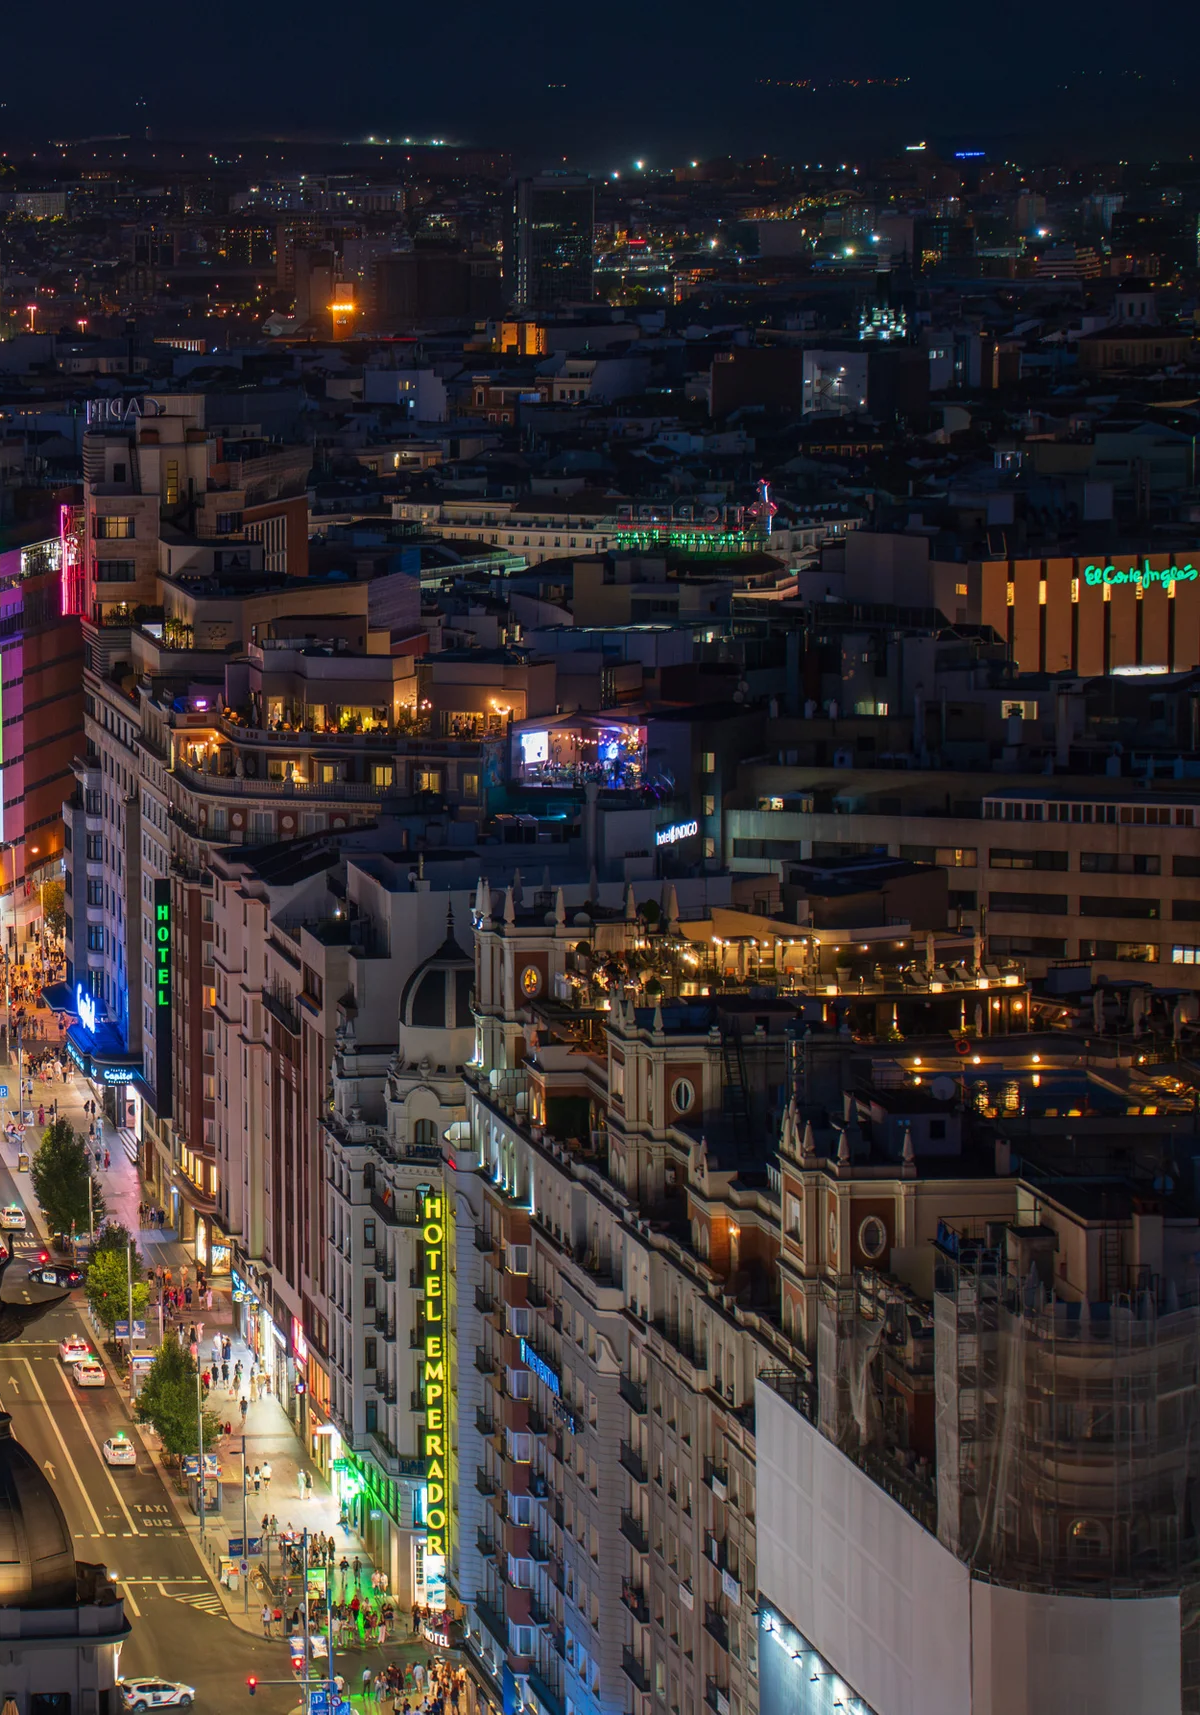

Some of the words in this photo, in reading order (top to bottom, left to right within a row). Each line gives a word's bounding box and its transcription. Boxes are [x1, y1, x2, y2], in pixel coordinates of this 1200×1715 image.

[1084, 565, 1103, 586] El
[1103, 565, 1142, 585] Corte
[1142, 559, 1198, 589] Inglés
[656, 830, 671, 846] hotel
[675, 821, 698, 840] INDIGO
[157, 905, 169, 1006] HOTEL
[104, 1070, 133, 1081] Capitol
[423, 1198, 443, 1322] HOTEL
[424, 1336, 446, 1556] EMPERADOR
[133, 1504, 169, 1513] TAXI
[143, 1518, 173, 1527] BUS
